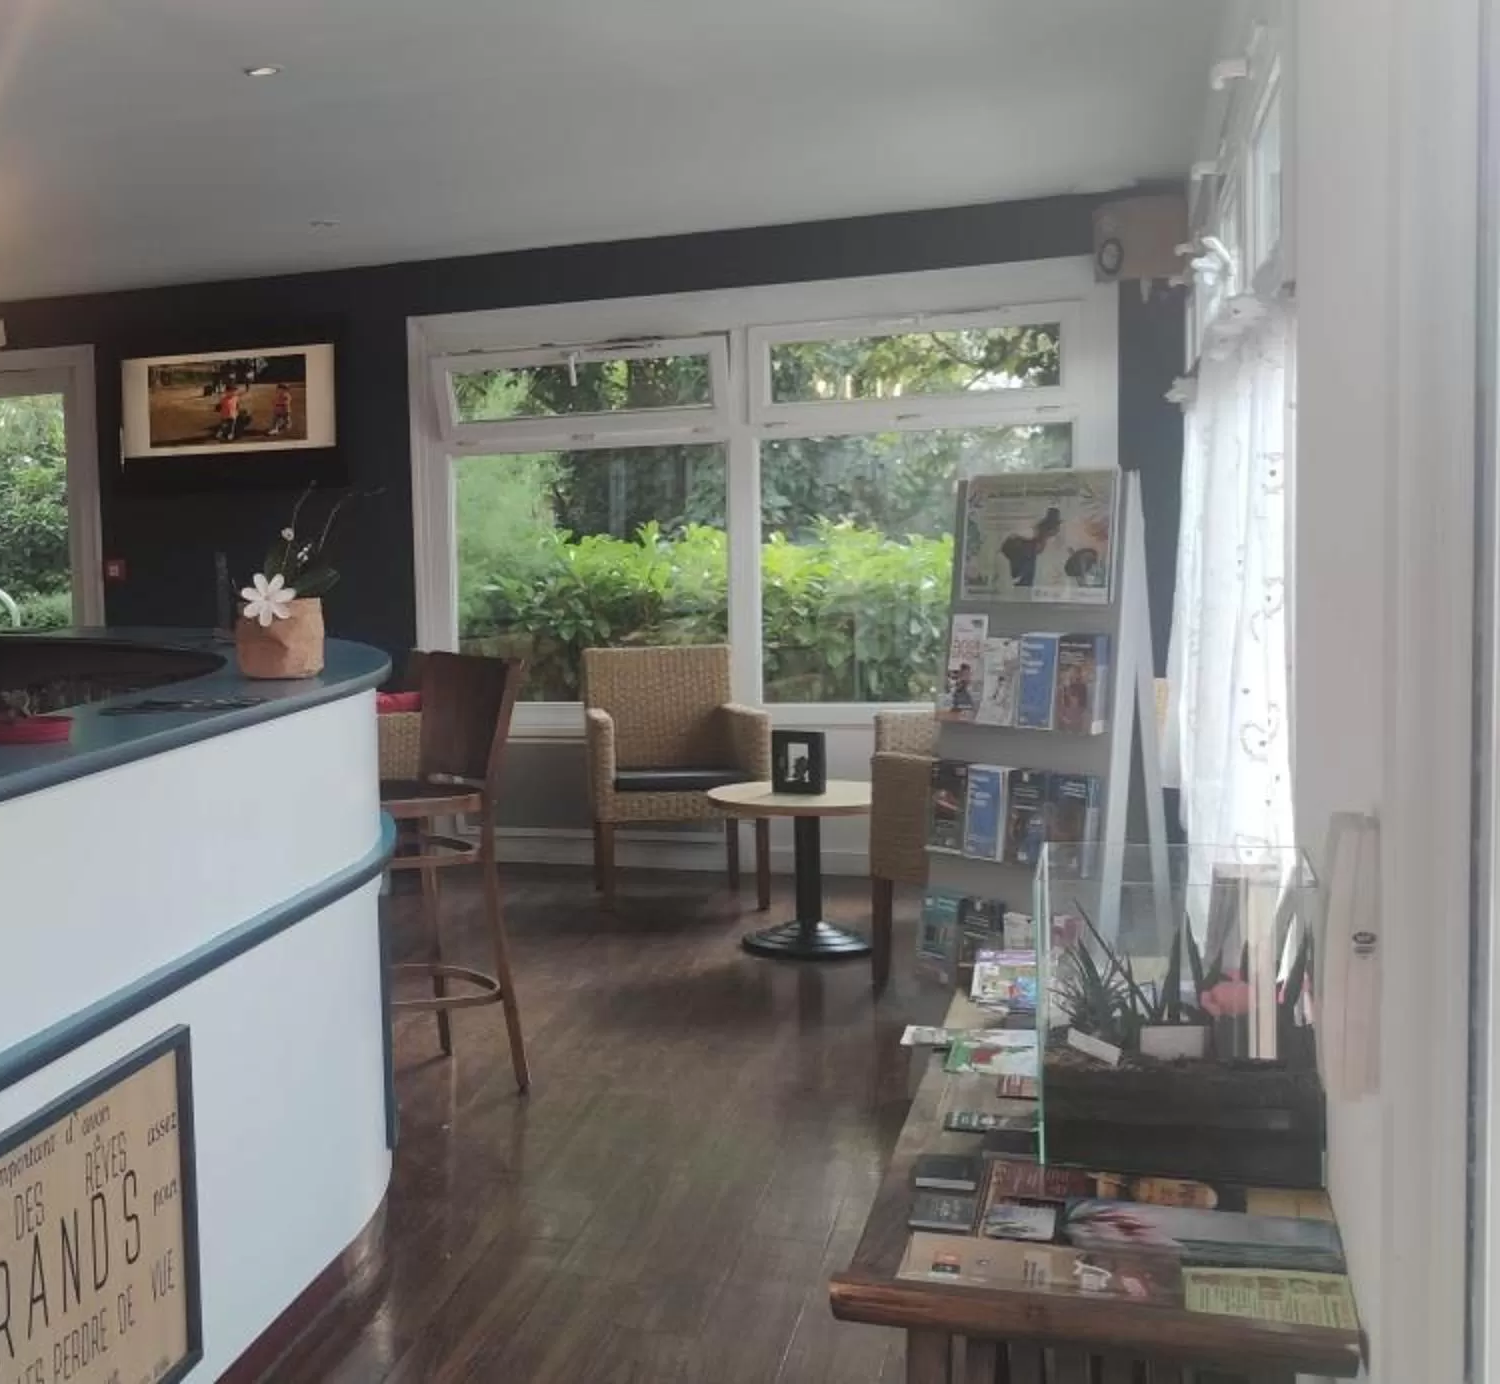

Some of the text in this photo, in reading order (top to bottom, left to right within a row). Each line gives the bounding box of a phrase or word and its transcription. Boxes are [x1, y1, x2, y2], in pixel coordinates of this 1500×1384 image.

[14, 1181, 45, 1241] DES
[85, 1130, 128, 1196] RÊVES
[52, 1307, 109, 1381] PERDRE
[117, 1283, 137, 1336] DE
[151, 1247, 177, 1303] VUE
